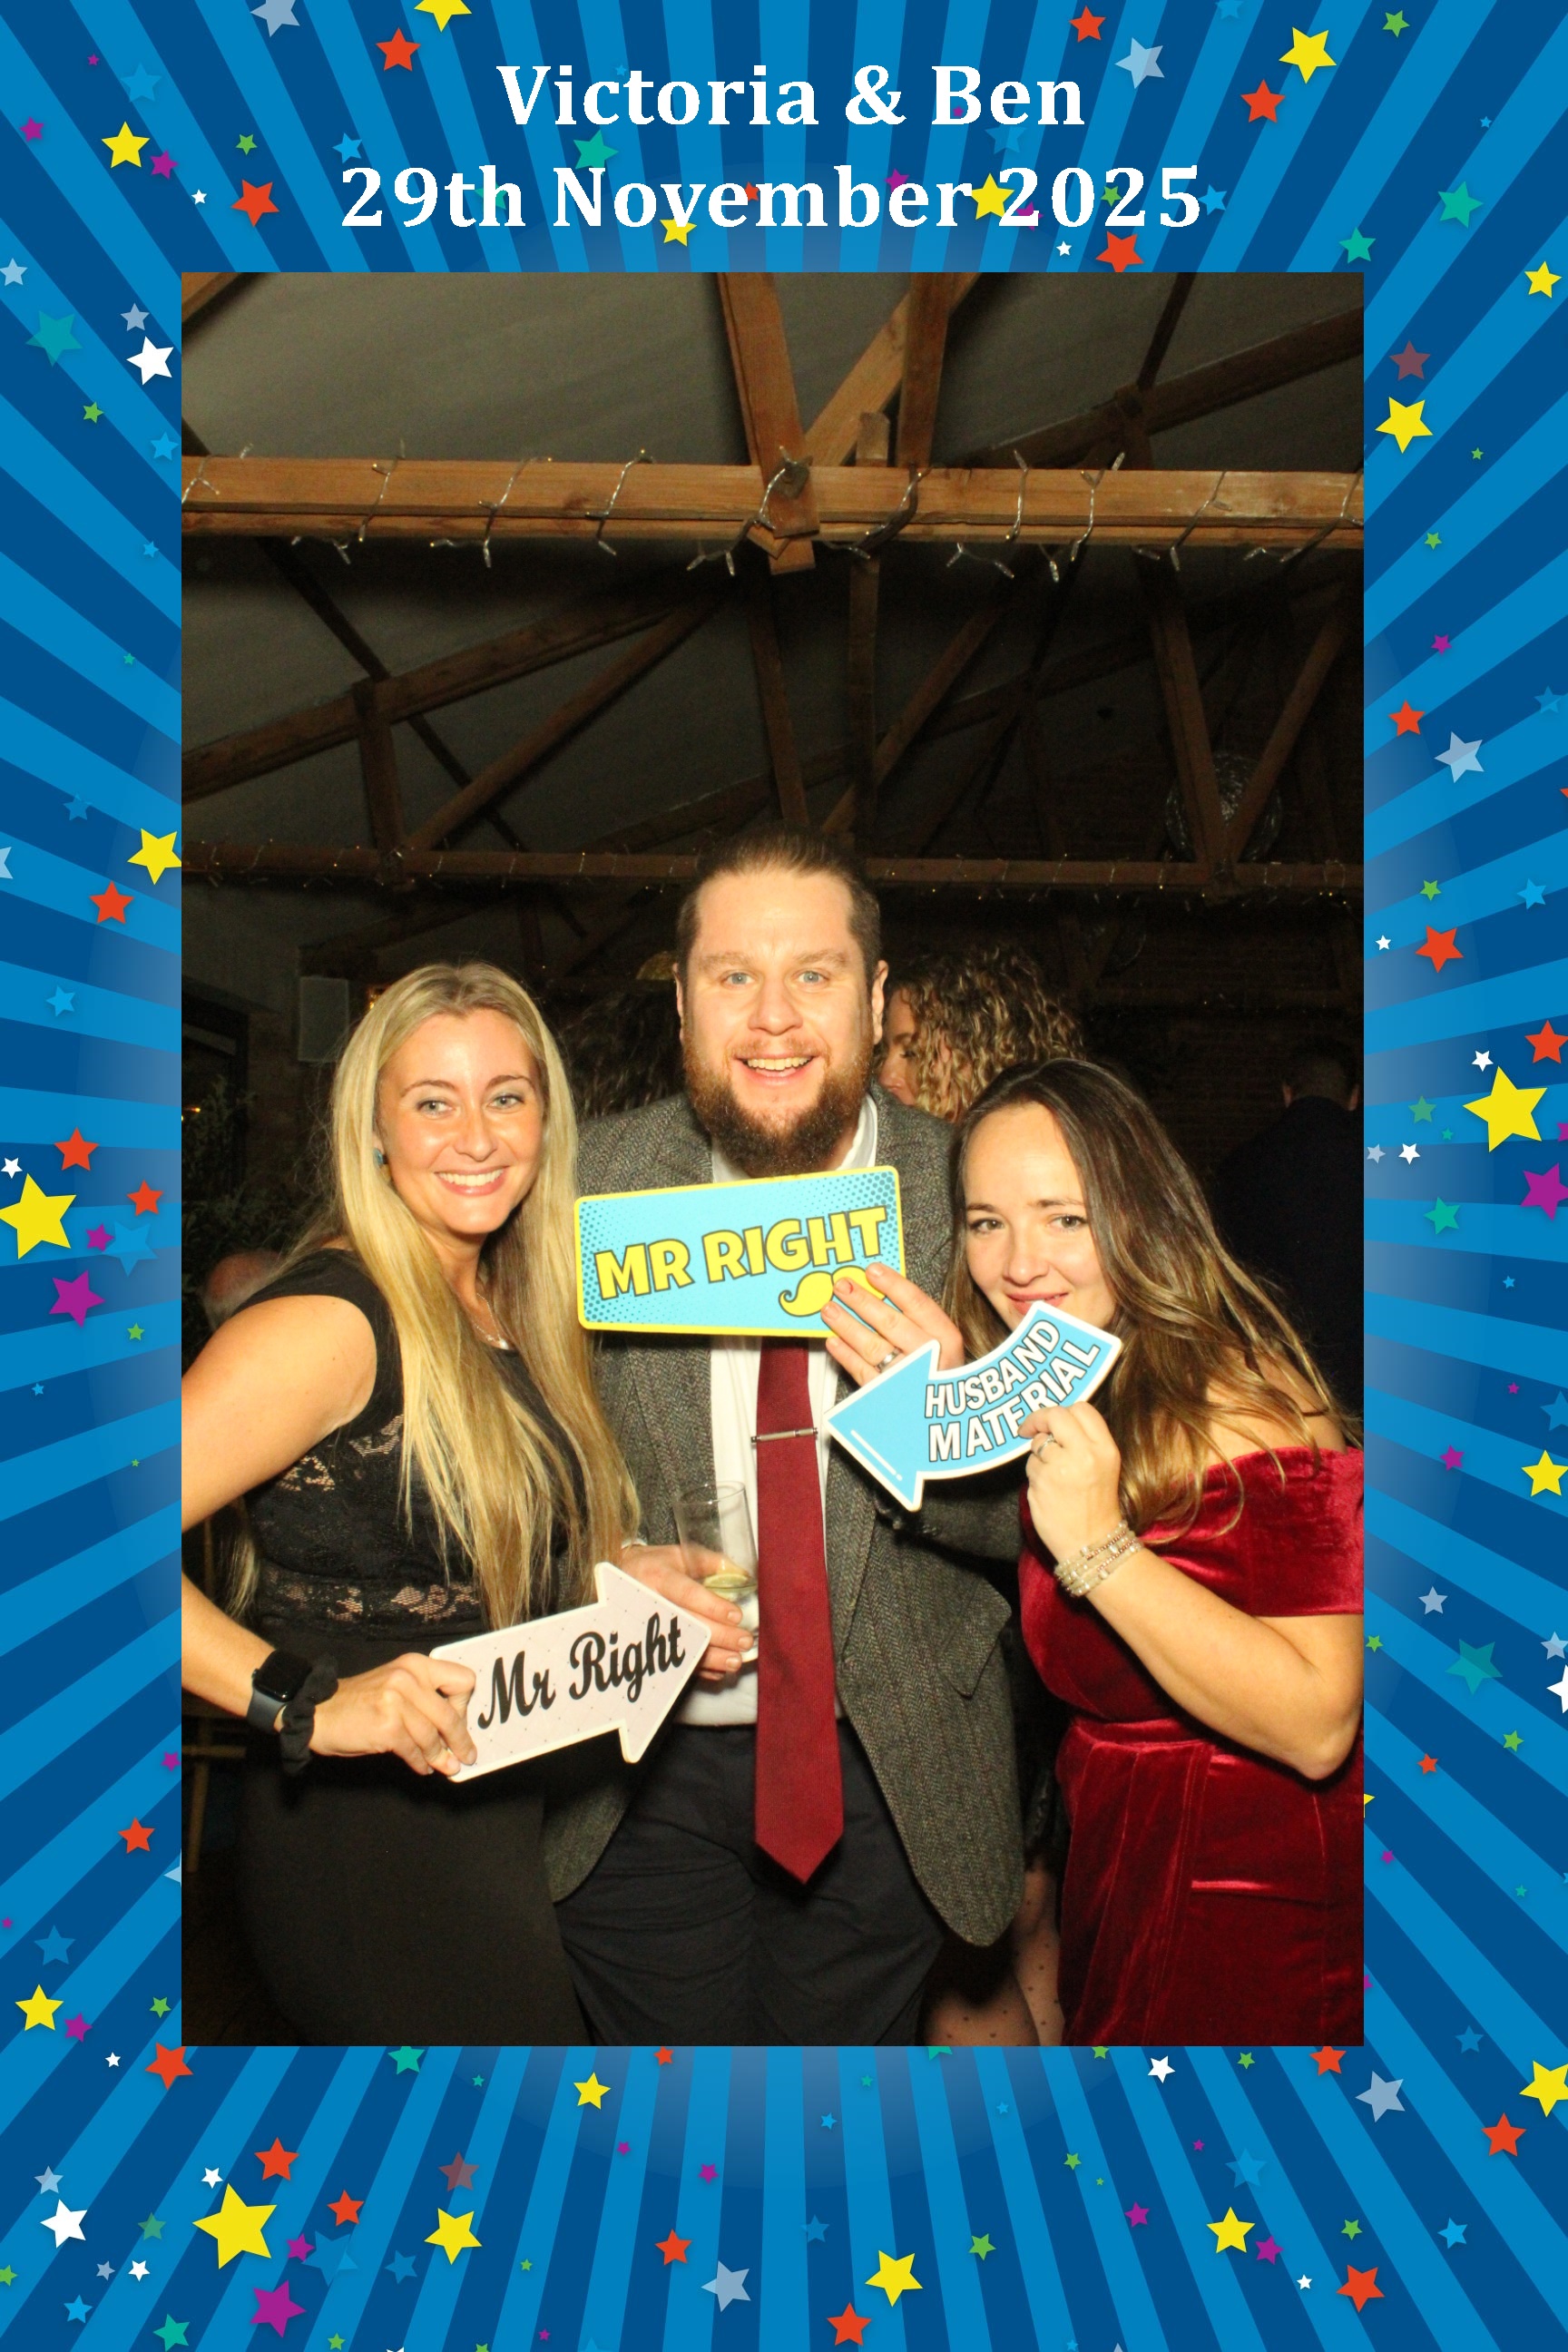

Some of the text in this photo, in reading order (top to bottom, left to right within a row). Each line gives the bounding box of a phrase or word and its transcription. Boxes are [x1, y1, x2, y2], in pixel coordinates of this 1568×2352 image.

[594, 1205, 887, 1300] MR RIGHT
[925, 1319, 1060, 1418] HUSBAND
[928, 1339, 1100, 1462] MATERIAL
[477, 1612, 686, 1730] Mr Right
